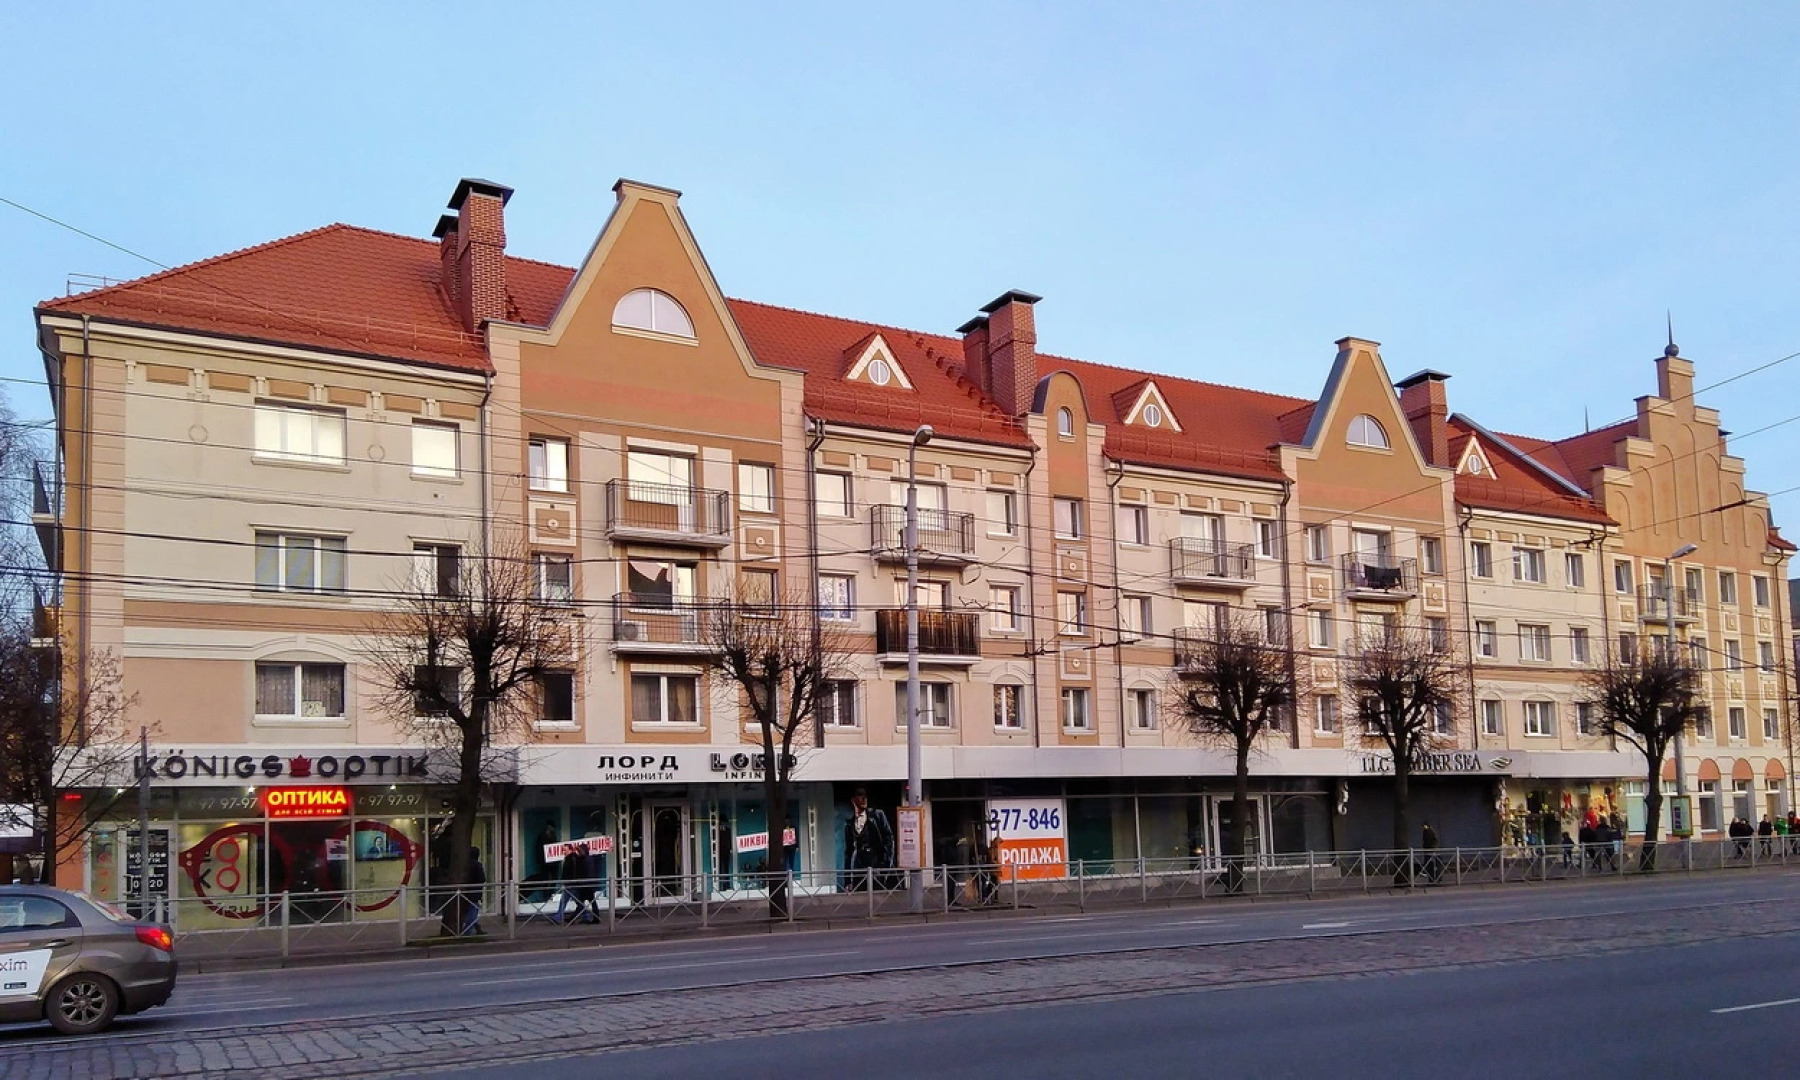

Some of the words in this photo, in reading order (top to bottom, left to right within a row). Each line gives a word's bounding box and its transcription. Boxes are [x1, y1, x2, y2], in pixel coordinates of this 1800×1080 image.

[133, 748, 282, 778] KÖNIGS
[317, 754, 429, 782] OPTIK
[597, 755, 679, 771] ЛОРД
[1453, 753, 1482, 772] SEA
[605, 772, 674, 781] ИНФИНИТИ
[267, 790, 347, 806] ОПТИКА
[1001, 846, 1062, 869] РОДАЖА
[0, 958, 27, 971] xim
